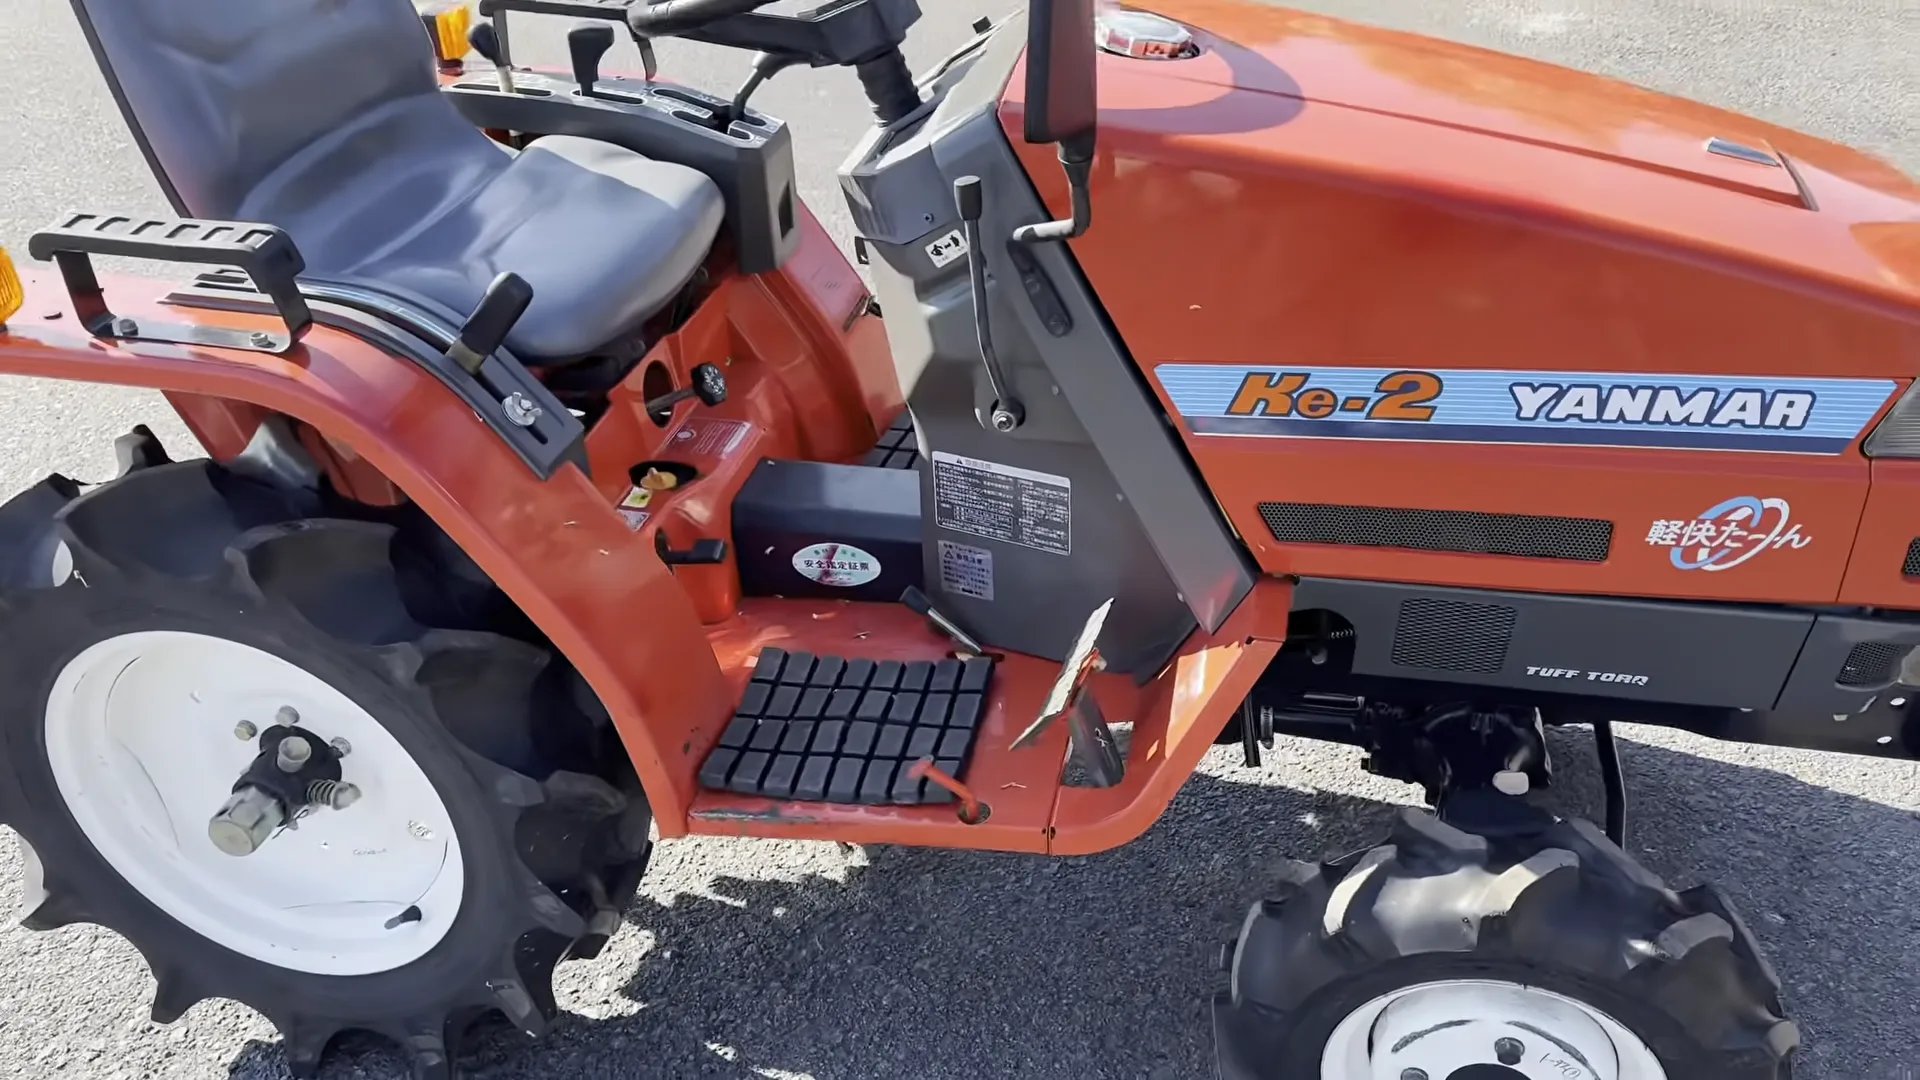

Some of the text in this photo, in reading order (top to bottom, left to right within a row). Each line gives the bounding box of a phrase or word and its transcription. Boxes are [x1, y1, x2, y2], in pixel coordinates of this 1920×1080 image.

[1225, 370, 1443, 421] Ke-2
[1509, 383, 1816, 429] YANMAR
[1526, 666, 1648, 686] TUFF TORQ
